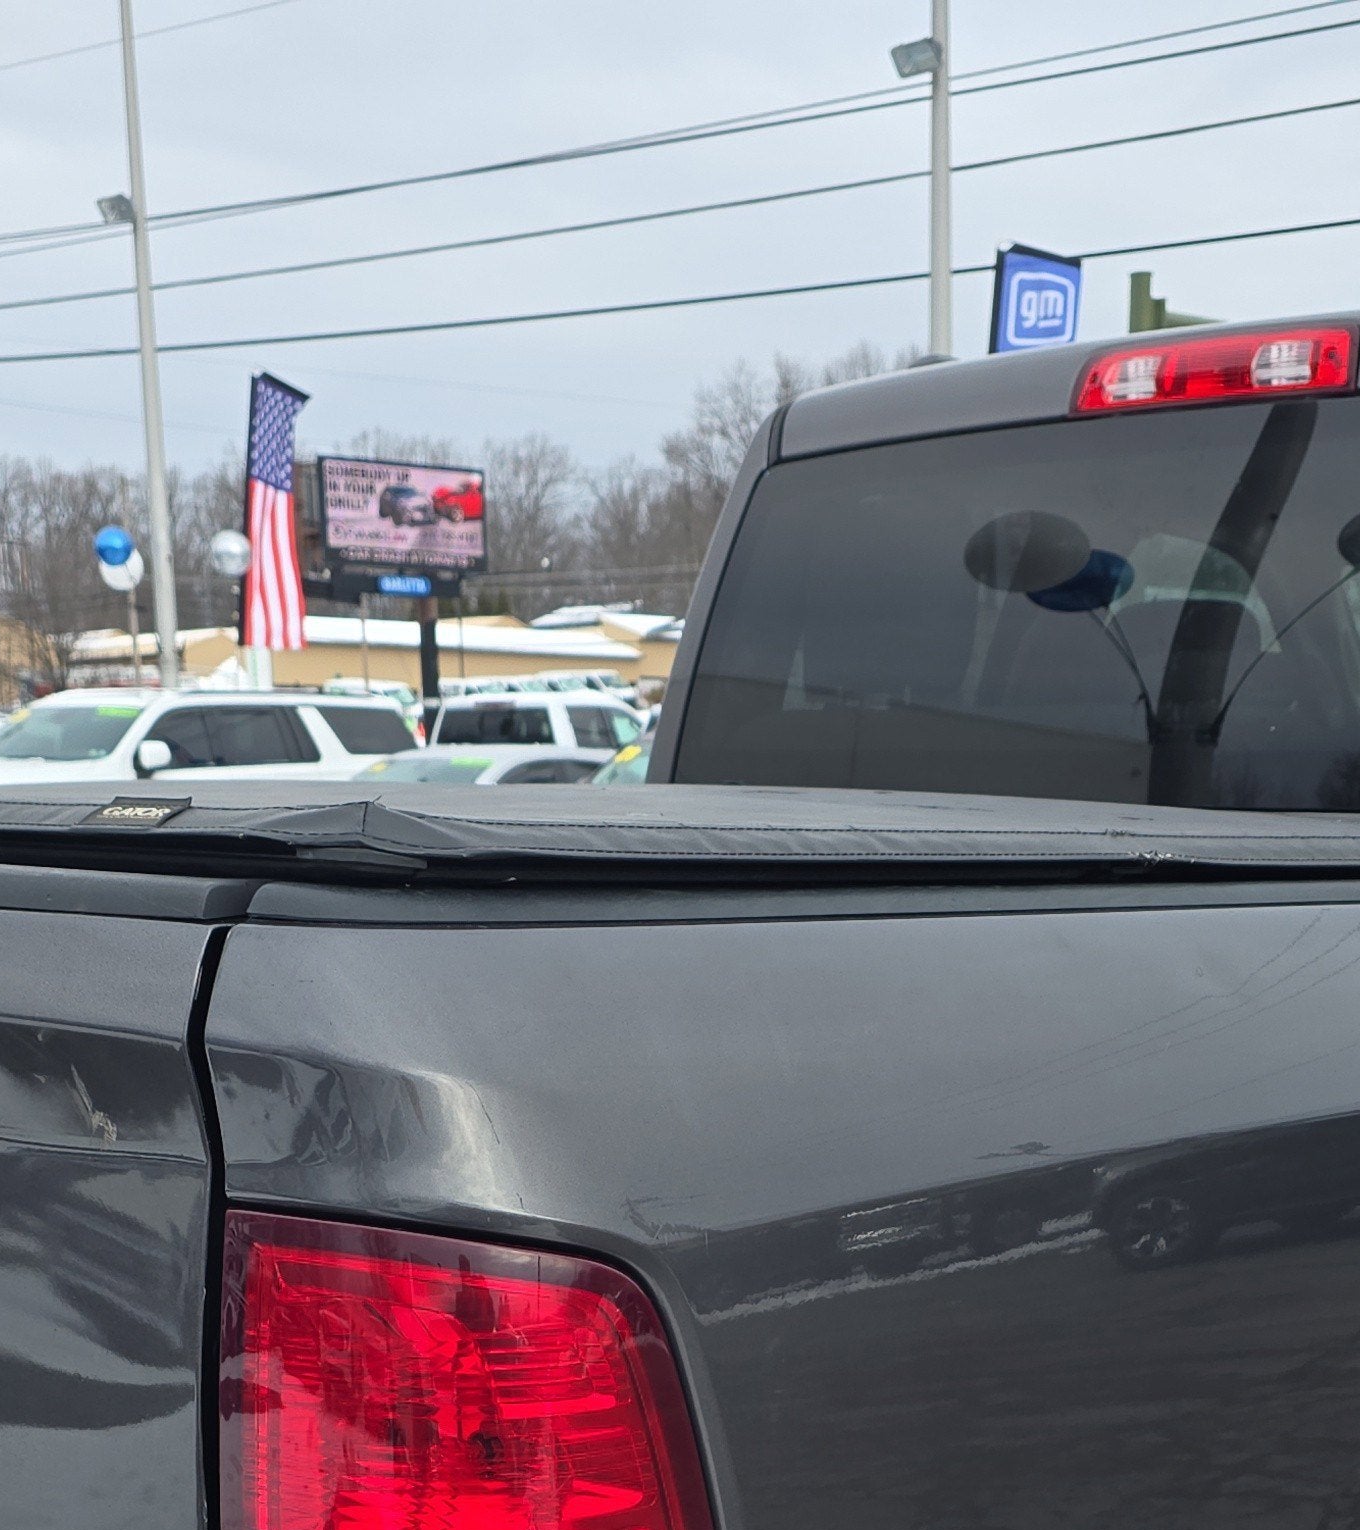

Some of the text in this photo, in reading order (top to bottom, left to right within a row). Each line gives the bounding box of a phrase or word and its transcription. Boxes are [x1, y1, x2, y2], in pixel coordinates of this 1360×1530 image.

[1020, 289, 1065, 329] gm
[343, 481, 377, 496] YOUR
[102, 806, 171, 818] GATOR
